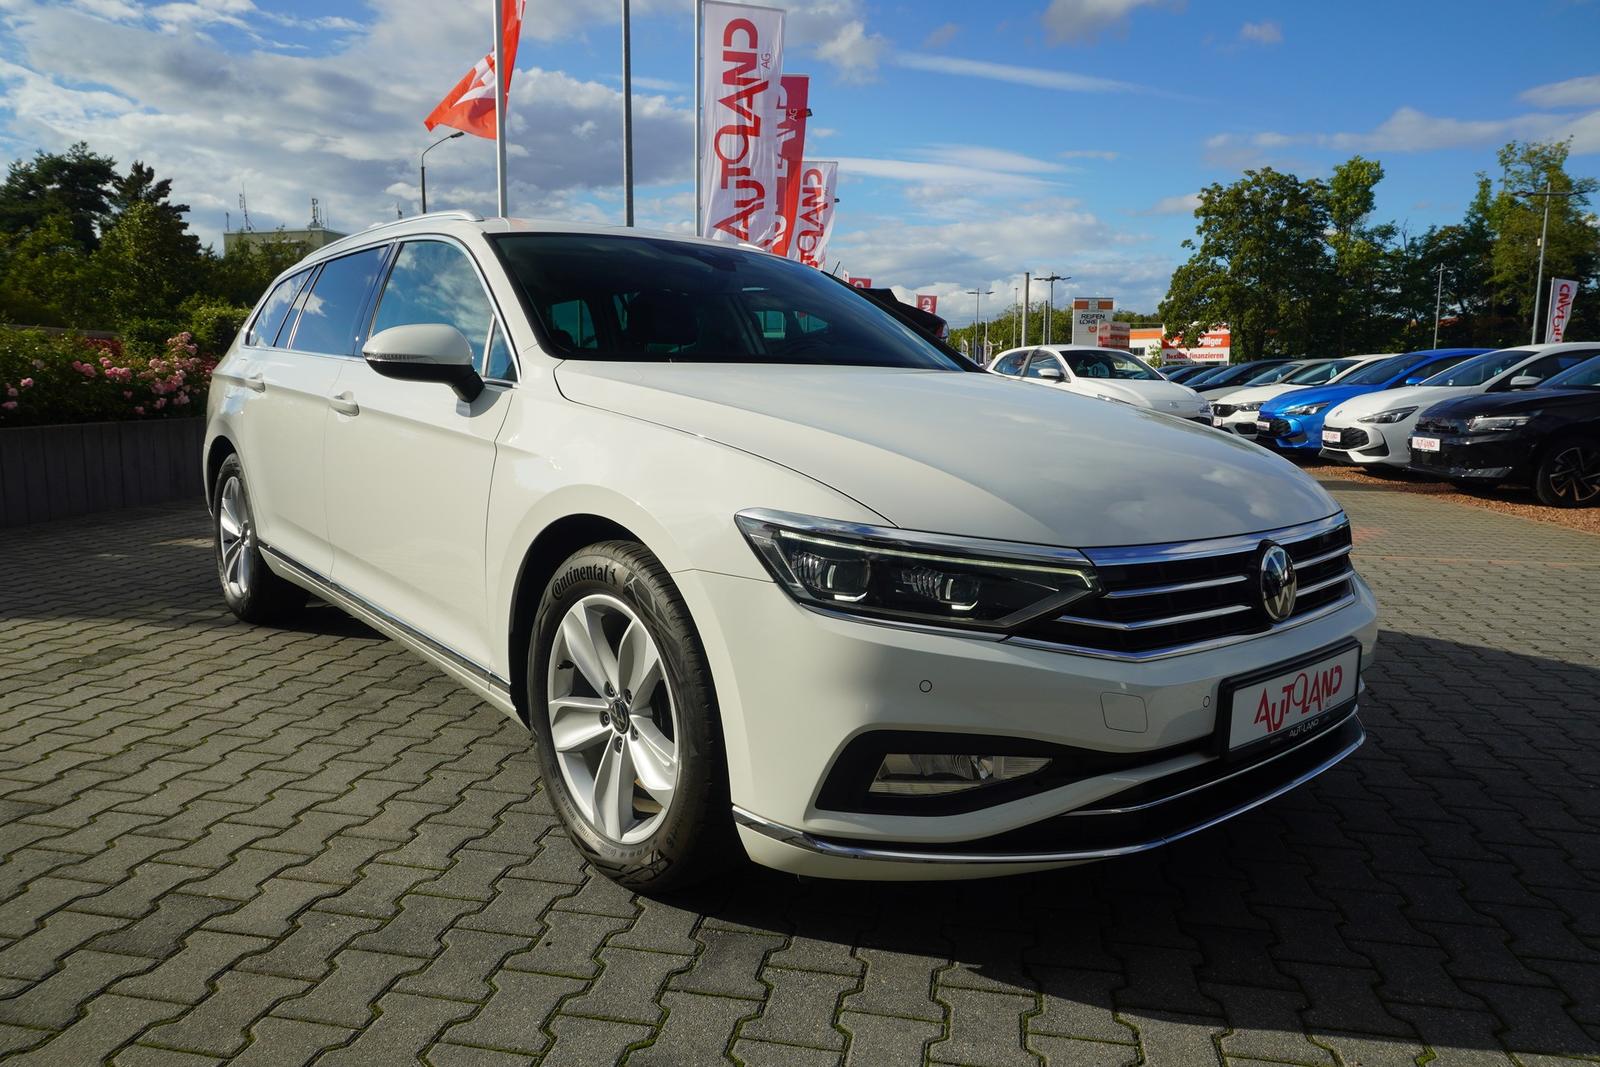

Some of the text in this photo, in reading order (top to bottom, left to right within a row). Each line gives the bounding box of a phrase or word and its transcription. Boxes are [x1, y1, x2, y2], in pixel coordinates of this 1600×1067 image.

[760, 53, 771, 70] AG
[788, 108, 798, 121] AG
[713, 18, 769, 243] AUTOLAND
[1189, 352, 1225, 360] finanzieren
[552, 563, 609, 600] Continental
[1253, 664, 1343, 733] AUTOLAND
